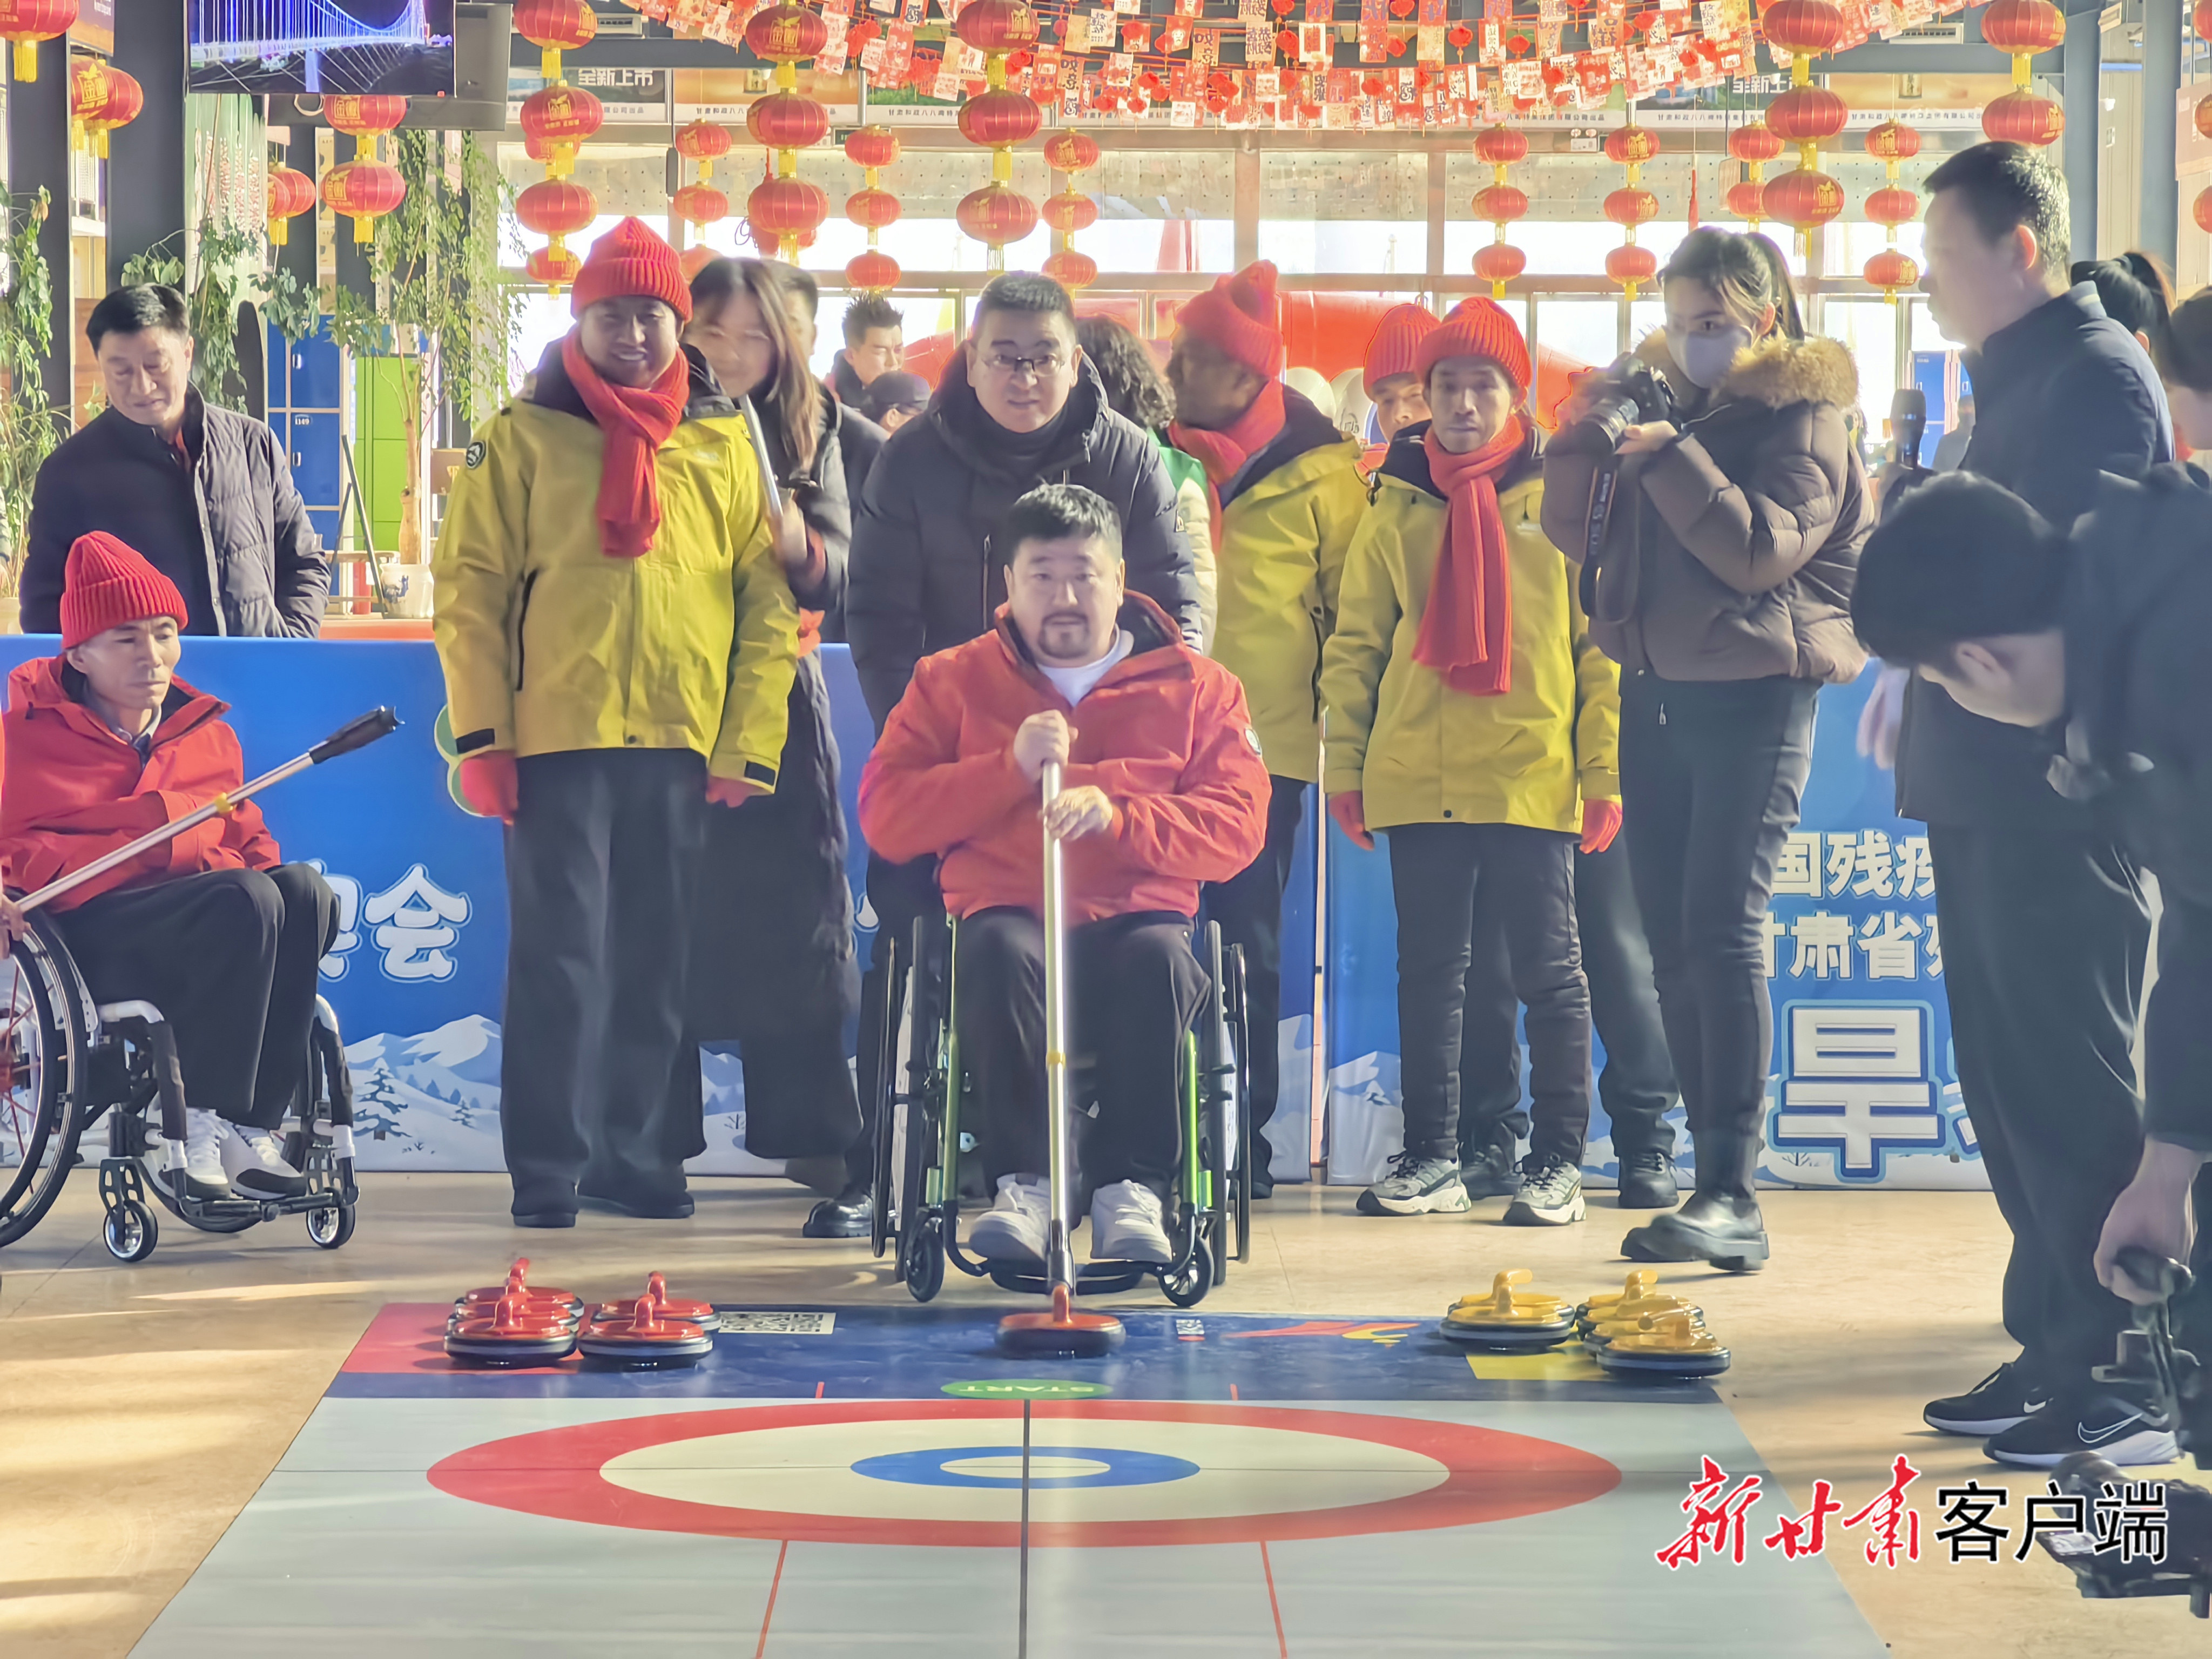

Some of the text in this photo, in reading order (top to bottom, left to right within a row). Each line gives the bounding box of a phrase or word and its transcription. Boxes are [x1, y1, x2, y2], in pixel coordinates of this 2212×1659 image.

[578, 69, 653, 86] 全新上市
[1732, 75, 1792, 93] 全新上
[1764, 911, 1943, 978] 肃省
[1777, 1007, 1977, 1169] 旱
